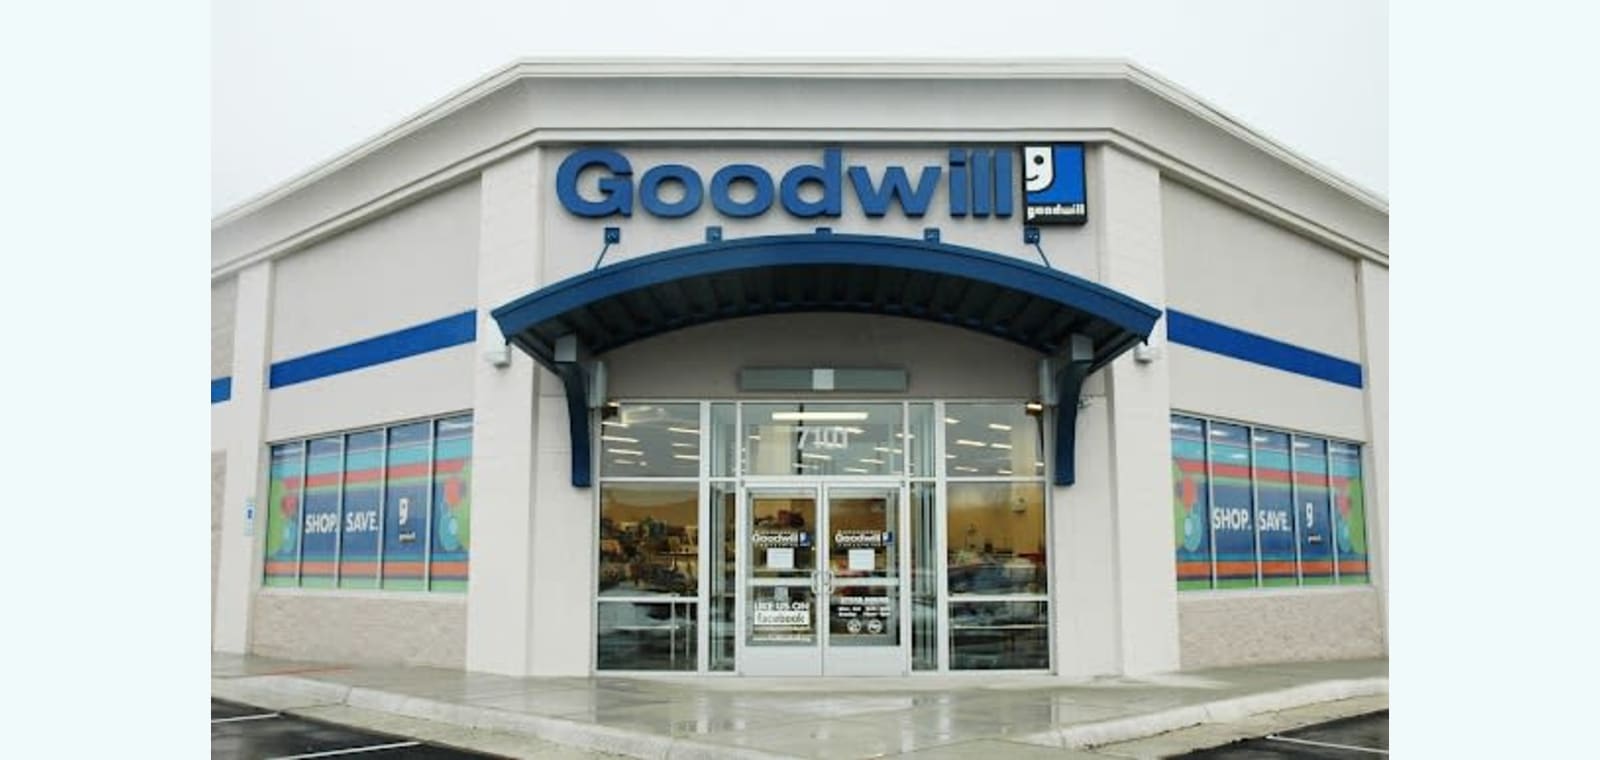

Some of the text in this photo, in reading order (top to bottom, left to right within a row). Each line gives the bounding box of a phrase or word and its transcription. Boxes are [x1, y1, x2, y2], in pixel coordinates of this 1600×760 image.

[556, 146, 1013, 219] Goodwill
[1027, 203, 1085, 220] goodwill
[305, 510, 379, 533] SHOP. SAVE.
[1213, 507, 1292, 531] SHOP. SAVE.
[752, 533, 798, 544] Goodwill
[835, 533, 881, 544] Goodwill
[792, 601, 809, 609] ON
